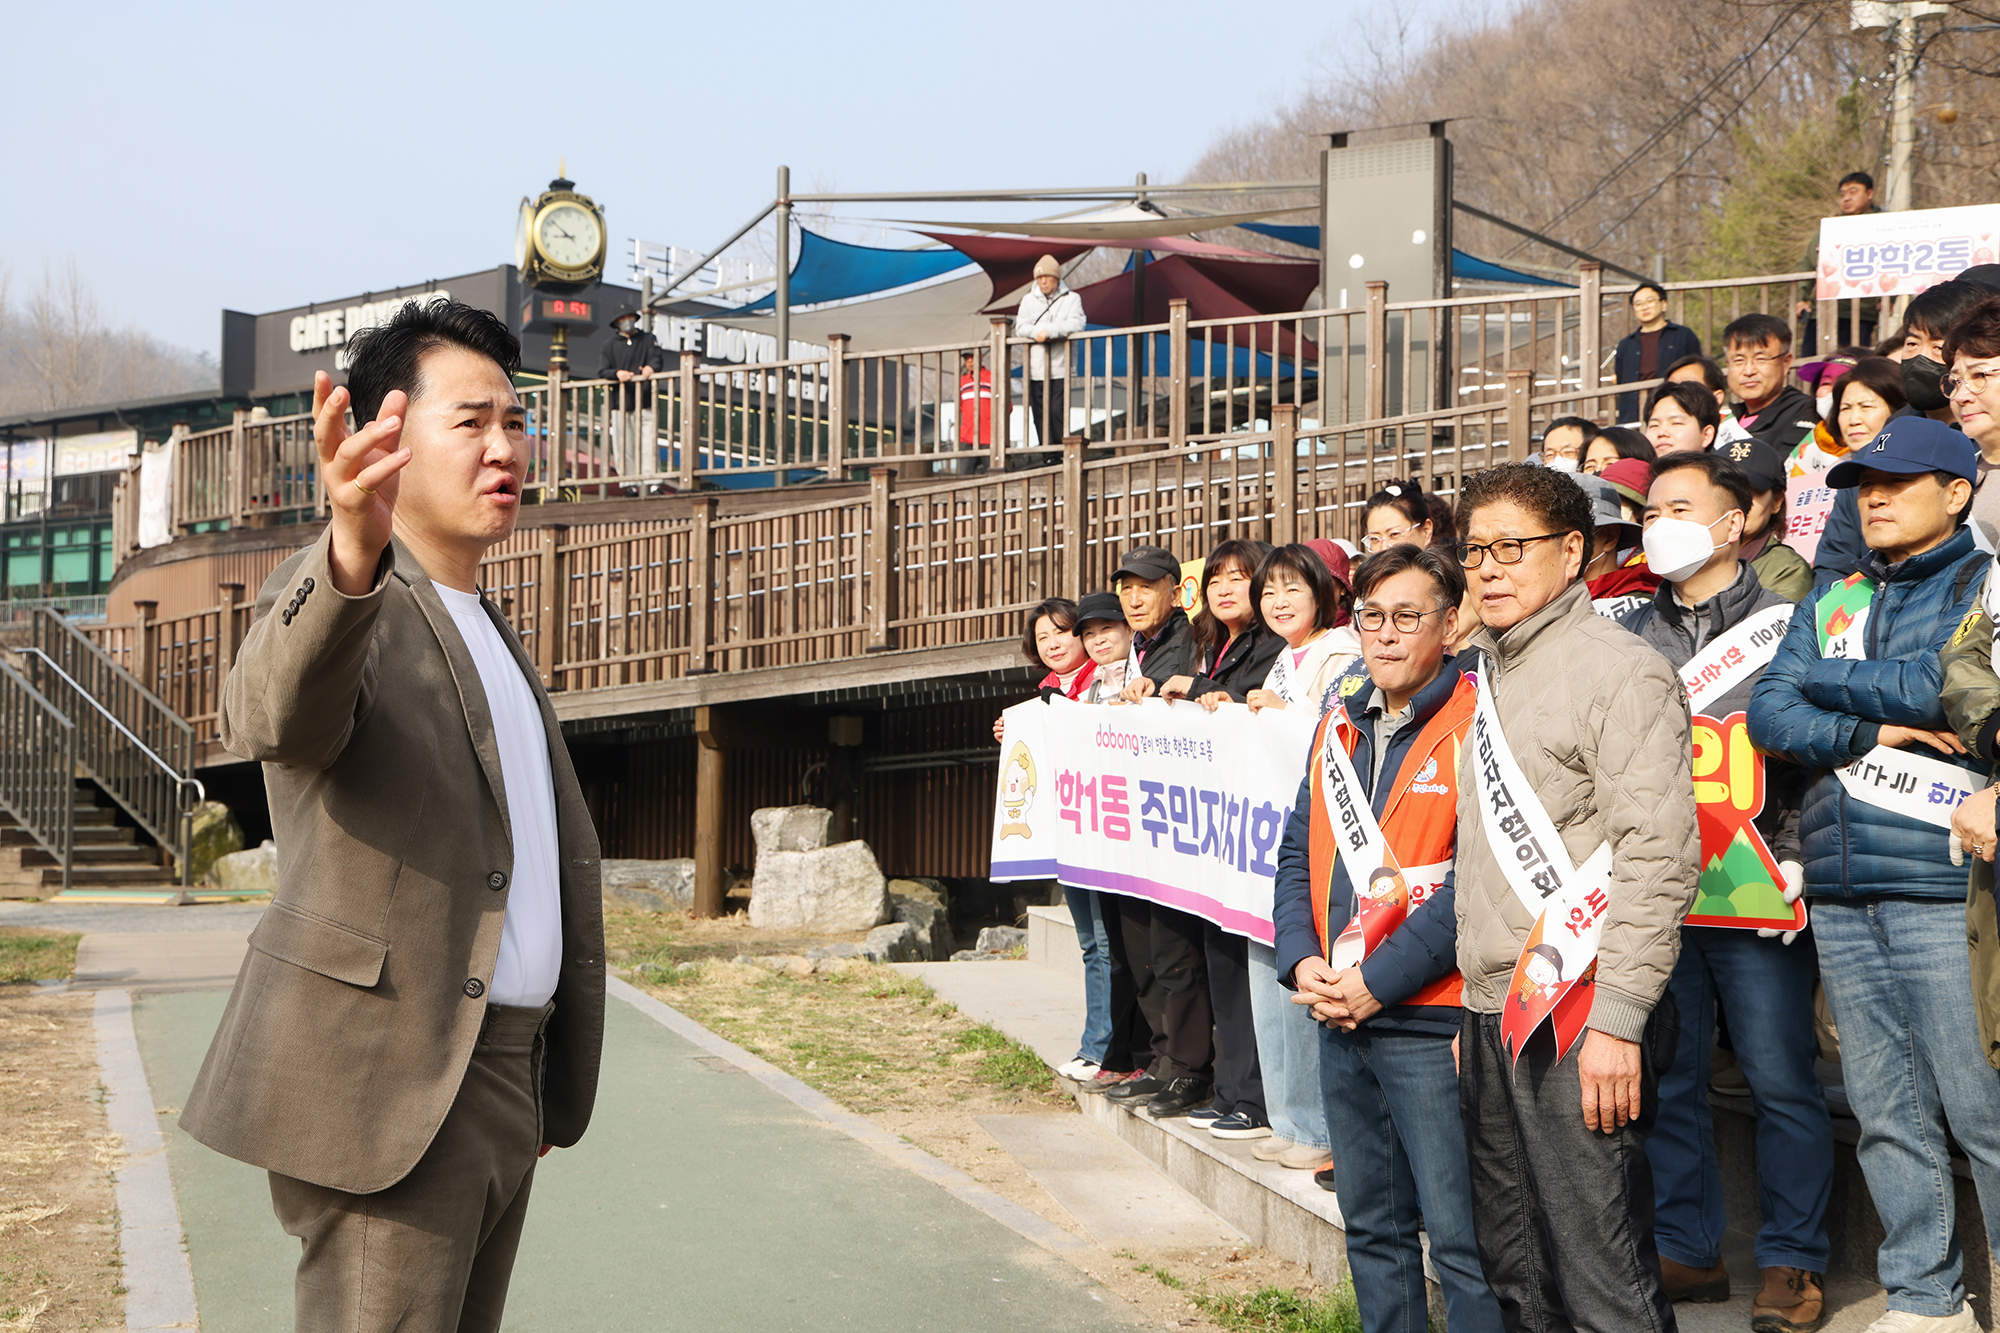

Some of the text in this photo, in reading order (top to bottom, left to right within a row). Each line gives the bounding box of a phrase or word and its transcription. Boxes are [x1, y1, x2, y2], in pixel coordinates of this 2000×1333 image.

[1846, 240, 1970, 278] 방학2동
[290, 308, 345, 352] CAFE
[1729, 442, 1752, 462] NY
[1786, 513, 1813, 538] 우는
[1684, 645, 1746, 699] 한순간
[1096, 722, 1140, 757] dobong
[1199, 738, 1213, 762] 도봉
[1055, 768, 1131, 841] 학1동
[1475, 710, 1563, 899] 주민자치협의회
[1564, 887, 1609, 939] 씨앗
